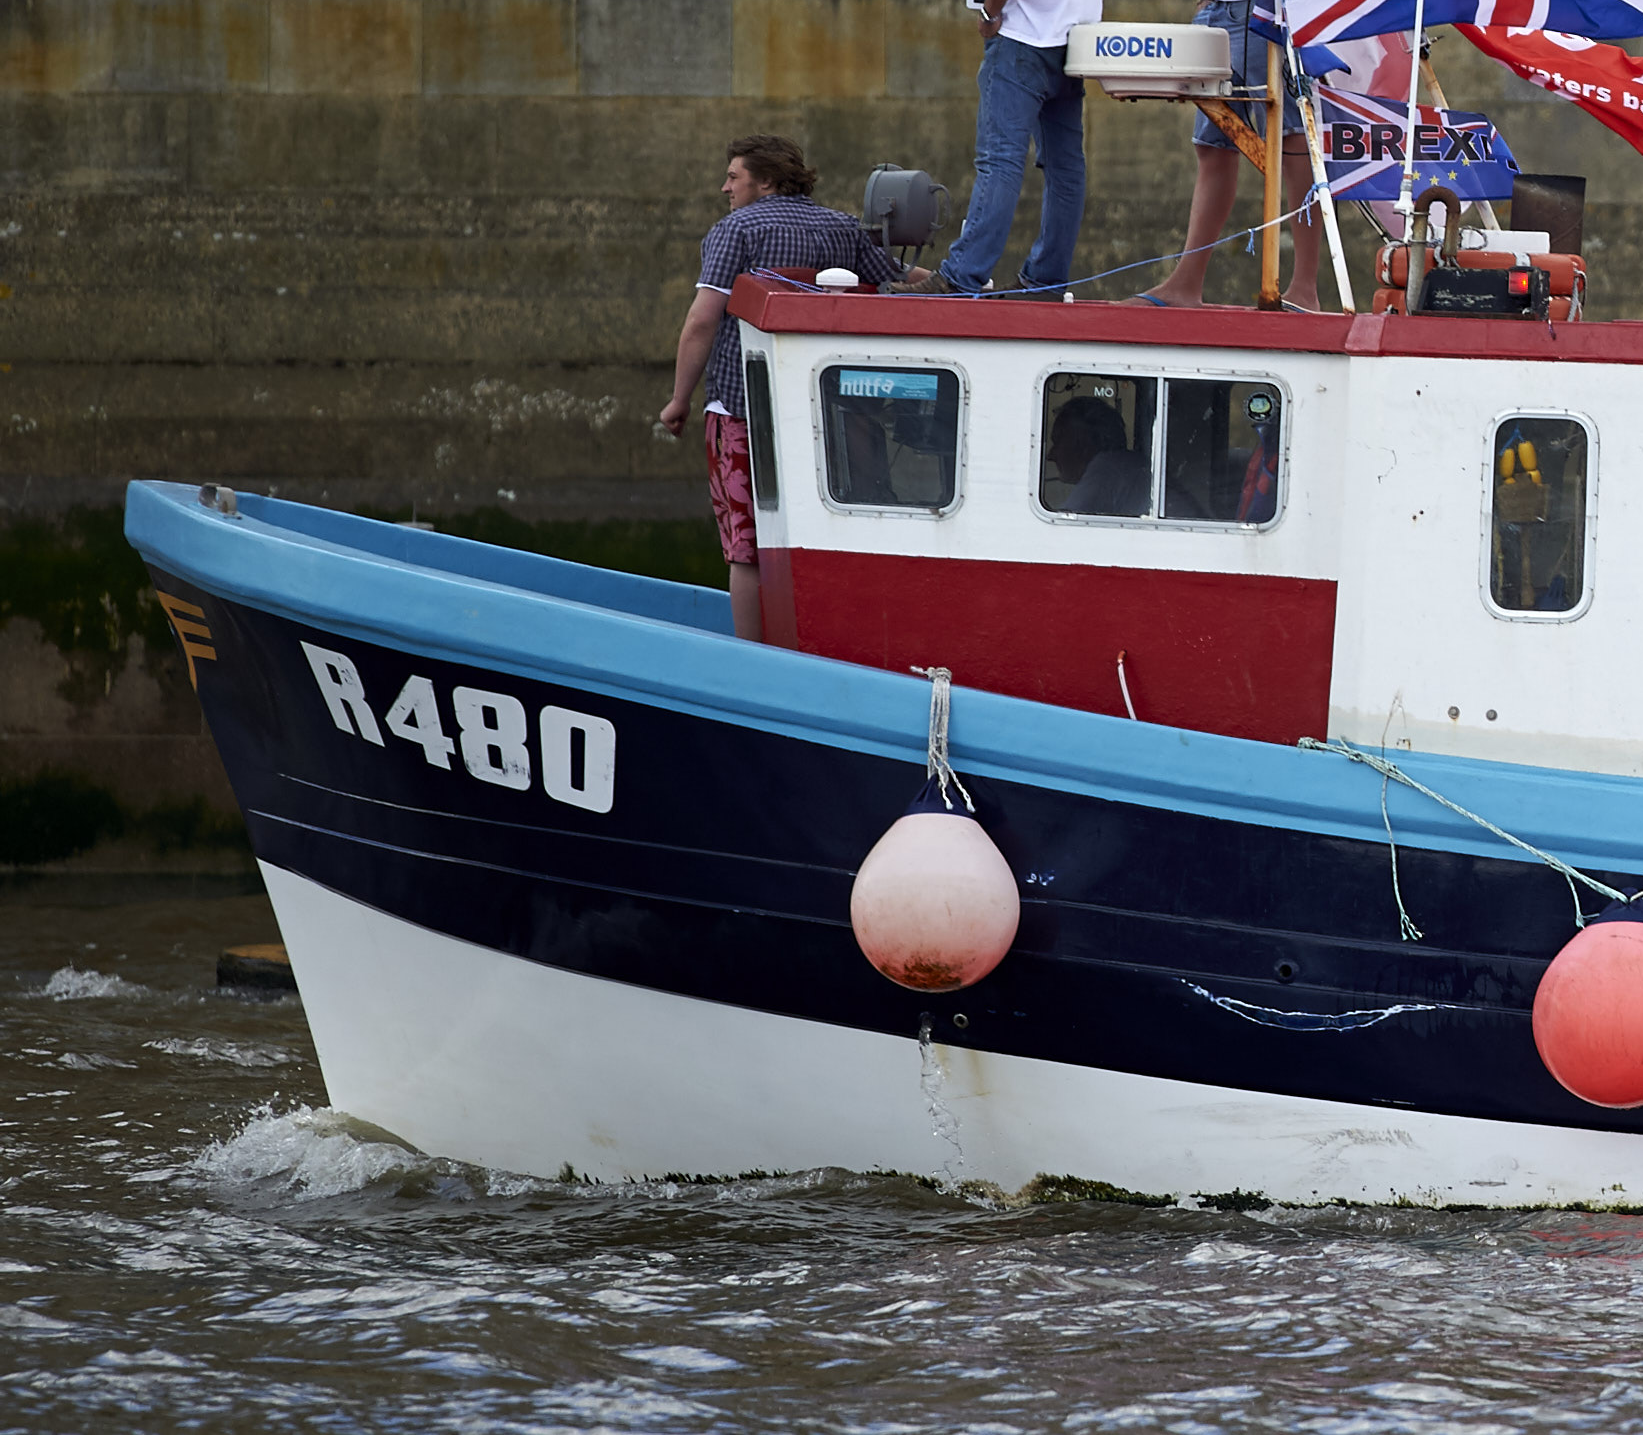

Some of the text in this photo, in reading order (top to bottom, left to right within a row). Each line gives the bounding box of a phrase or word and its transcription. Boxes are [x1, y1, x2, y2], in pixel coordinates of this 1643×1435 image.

[1095, 35, 1173, 59] KODEN
[840, 376, 895, 398] nutfa
[299, 639, 617, 814] R480
